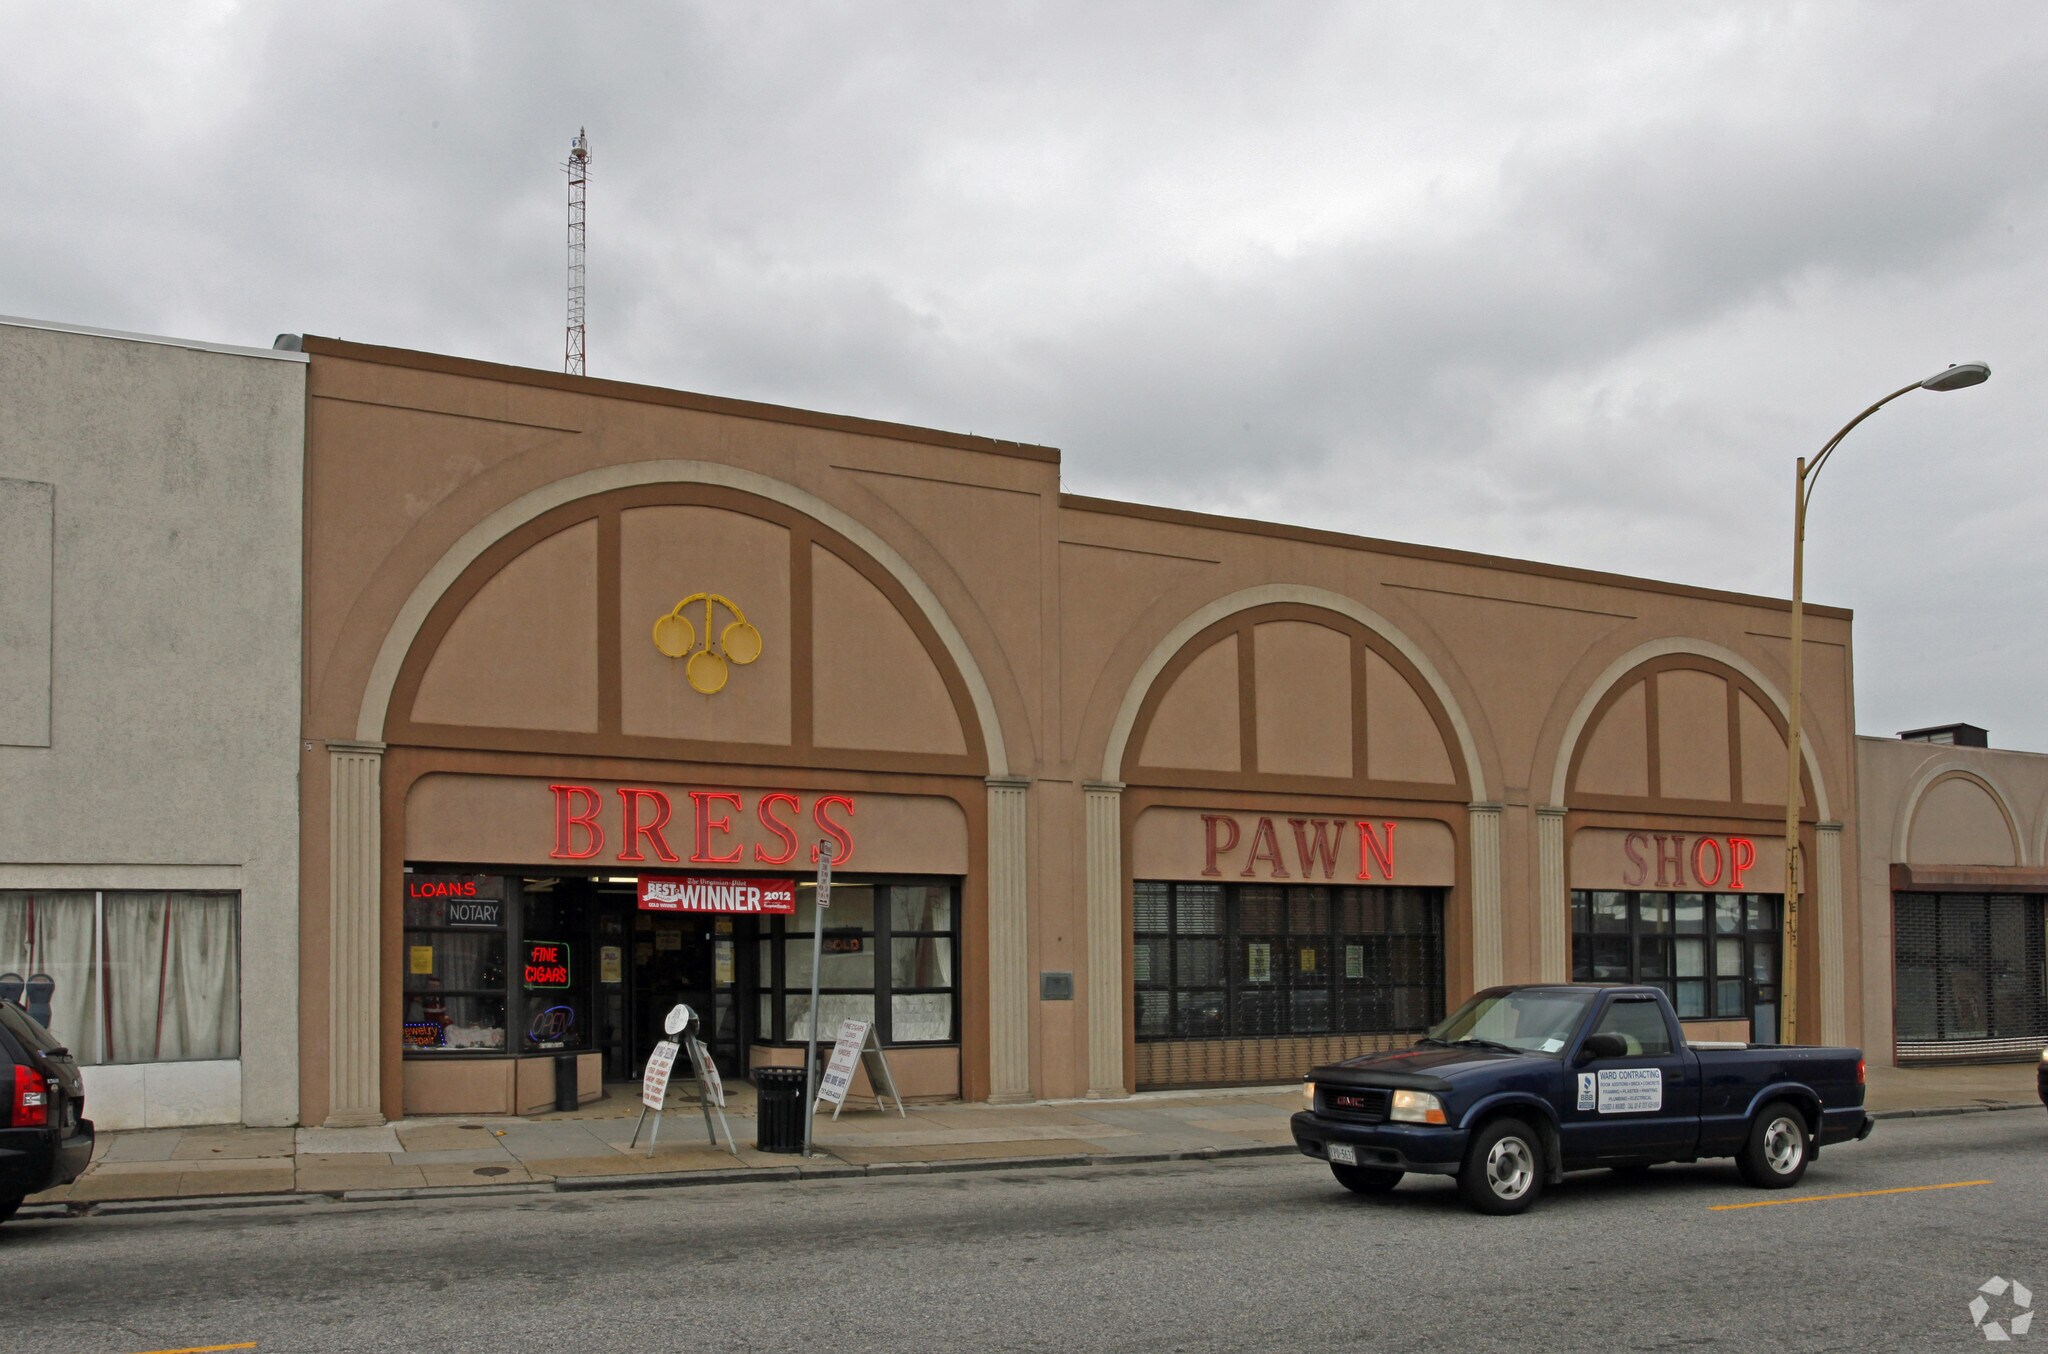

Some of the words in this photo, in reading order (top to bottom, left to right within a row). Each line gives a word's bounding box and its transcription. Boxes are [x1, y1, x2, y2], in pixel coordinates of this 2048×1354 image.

[549, 785, 854, 866] BRESS
[1201, 814, 1397, 880] PAWN
[1623, 832, 1756, 889] SHOP
[410, 881, 477, 897] LOANS
[648, 882, 676, 896] BEST
[700, 878, 747, 887] Virginian-Pilot
[680, 884, 761, 911] WINNER
[763, 891, 791, 901] 2012
[450, 904, 498, 921] NOTARY
[532, 947, 558, 963] FINE
[525, 965, 567, 983] CIGARS
[533, 1012, 570, 1036] OPEN
[1600, 1071, 1617, 1080] WARD
[1619, 1070, 1660, 1079] CONTRACTING
[1337, 1096, 1364, 1107] GMC
